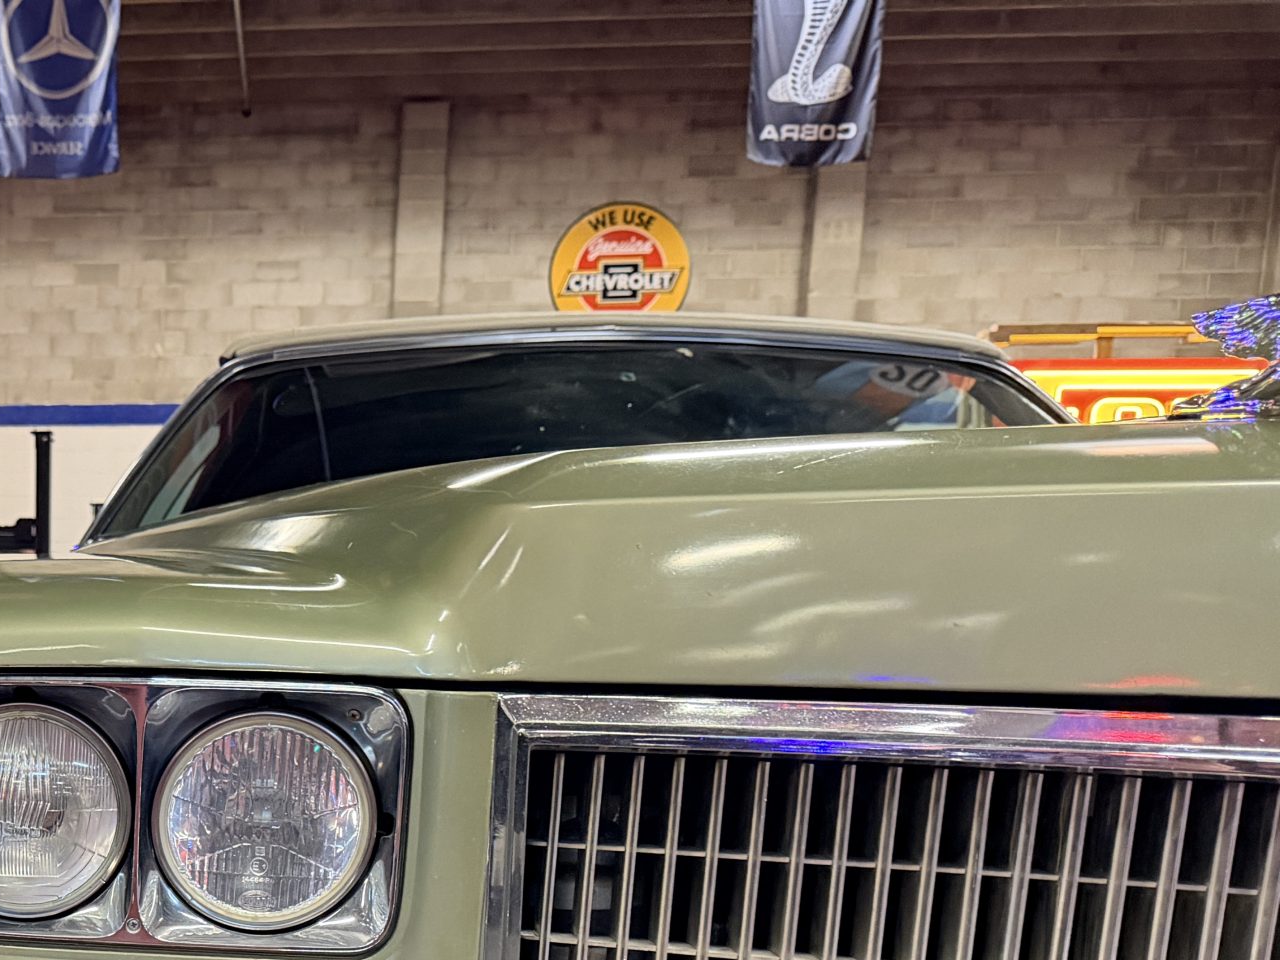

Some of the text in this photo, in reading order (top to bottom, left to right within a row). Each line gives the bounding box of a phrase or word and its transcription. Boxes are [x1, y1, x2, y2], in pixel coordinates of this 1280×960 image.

[588, 209, 657, 231] WE USE
[568, 273, 675, 292] CHEVROLET
